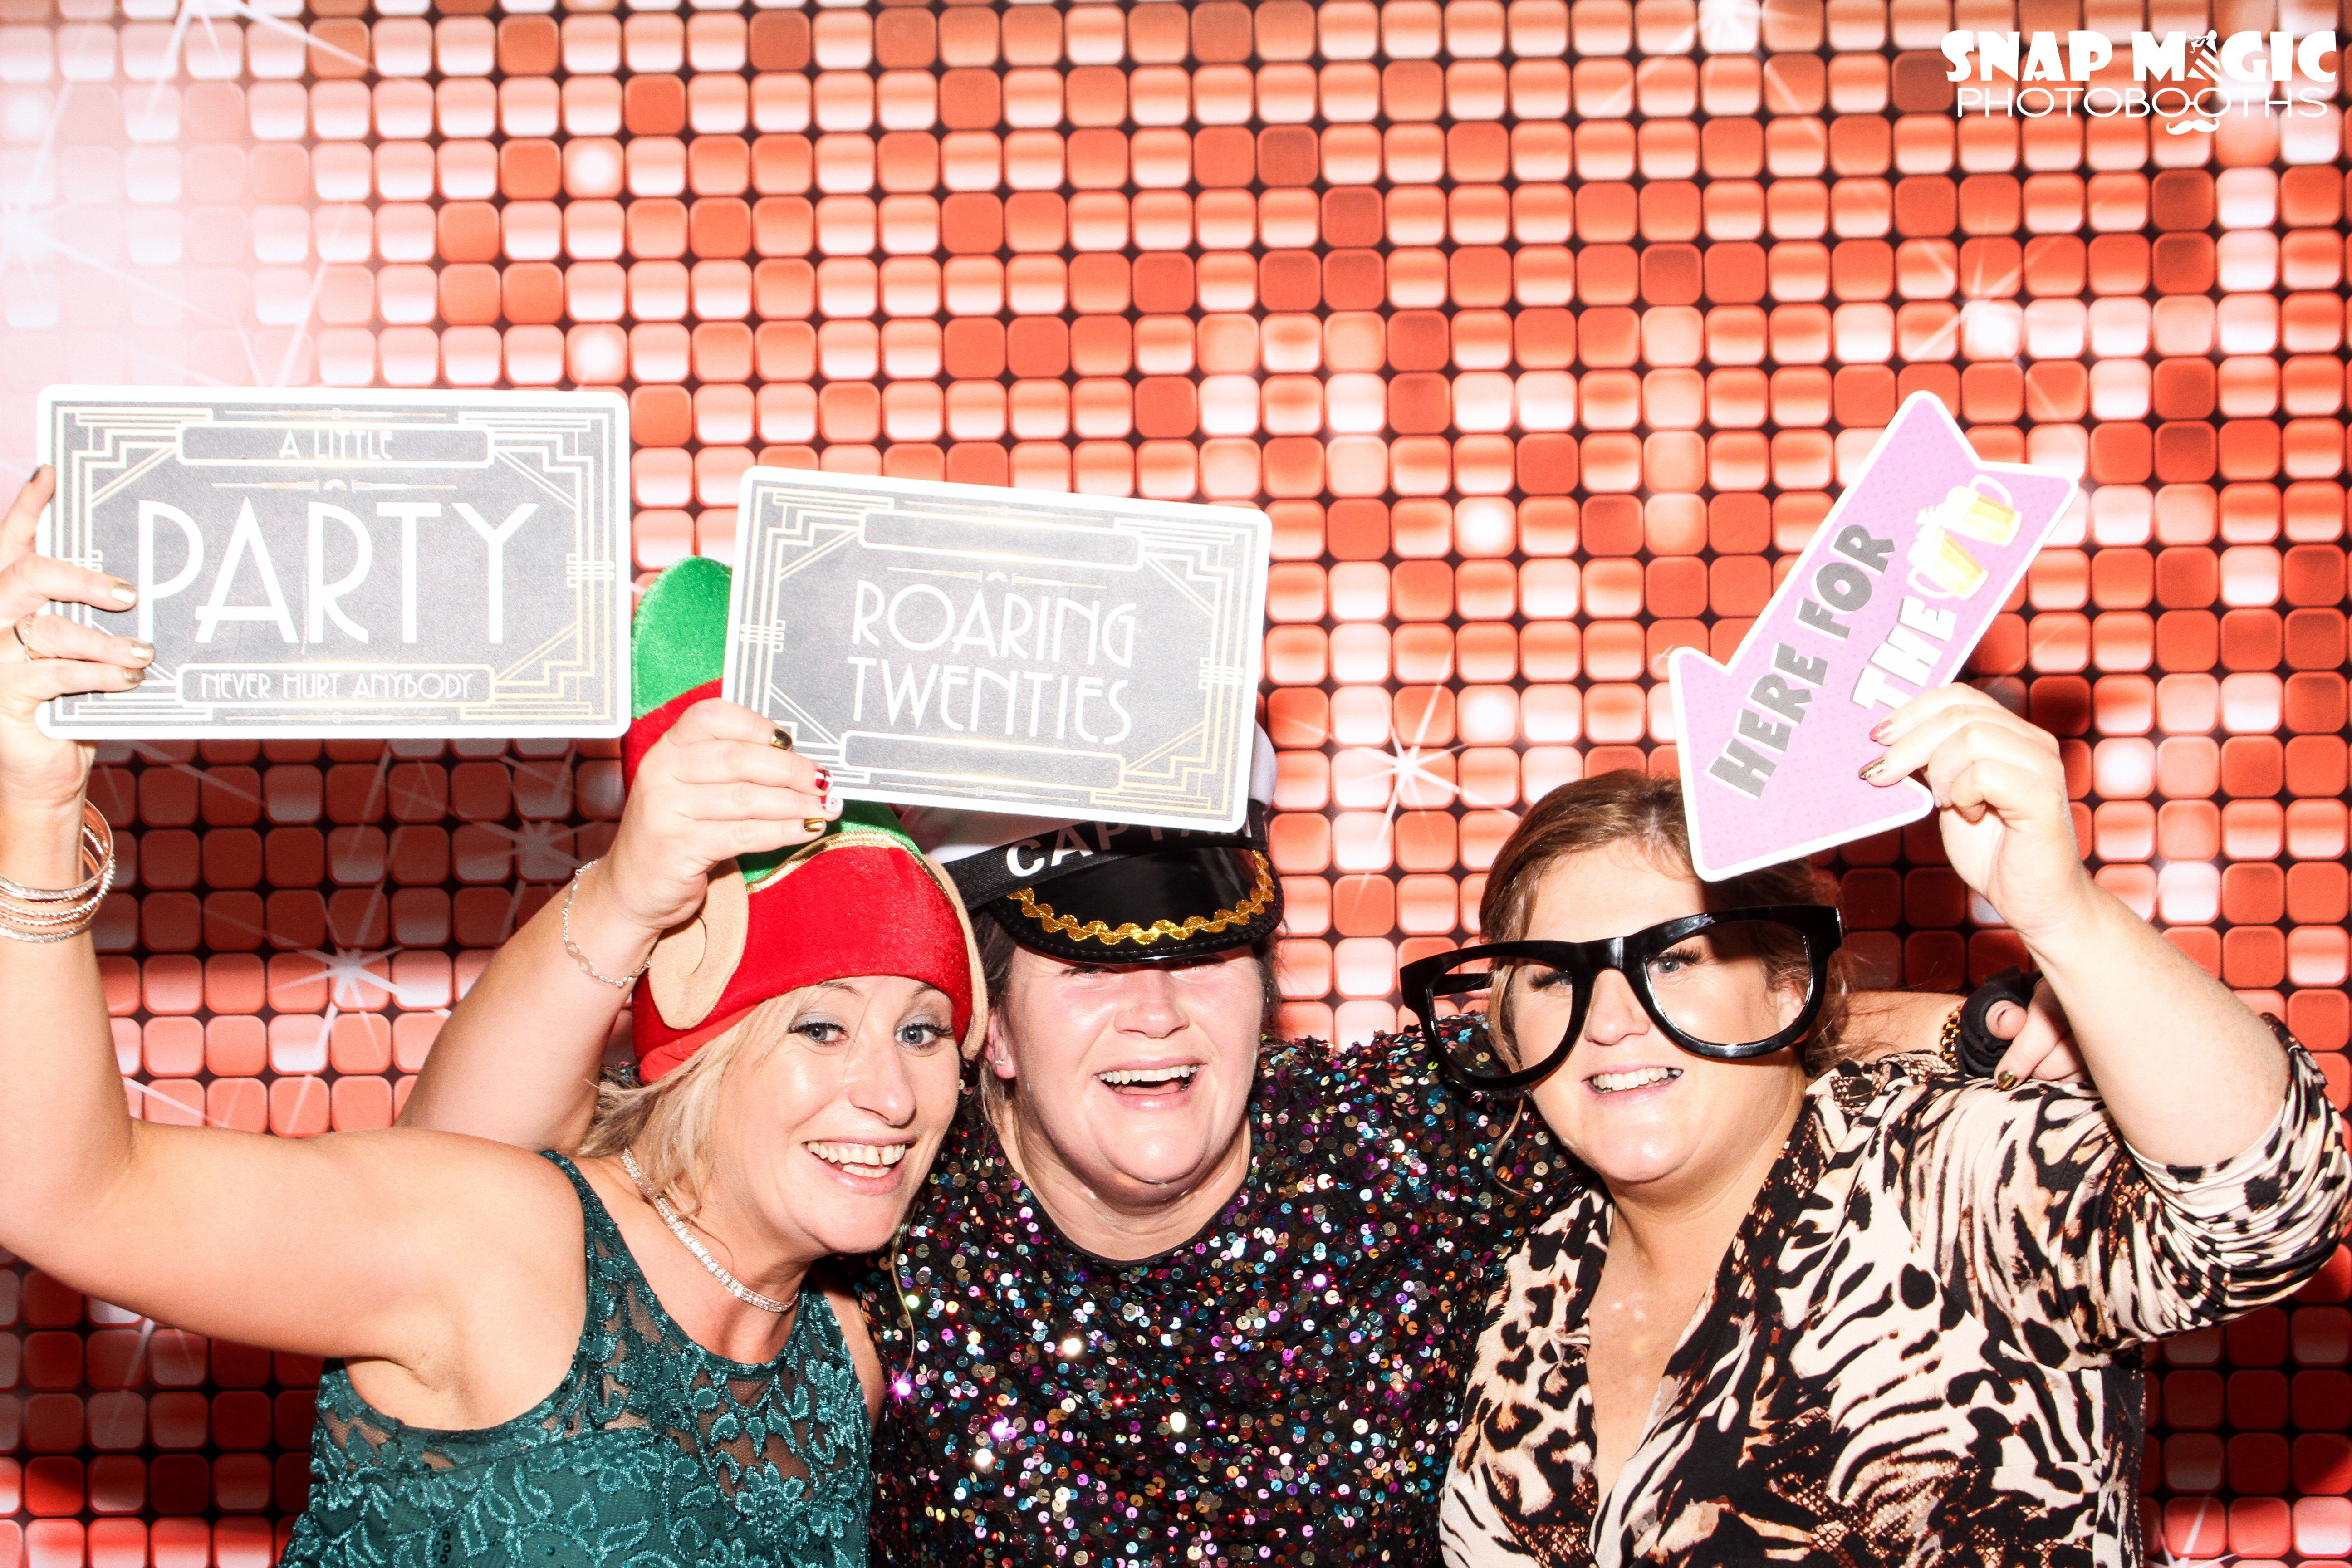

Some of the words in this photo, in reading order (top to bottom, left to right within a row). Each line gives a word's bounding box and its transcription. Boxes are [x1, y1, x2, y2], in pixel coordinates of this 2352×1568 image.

[279, 429, 300, 460] A
[314, 429, 393, 460] LITTLE
[137, 496, 539, 644] PARTY
[851, 579, 1136, 669] ROARING
[1704, 642, 1828, 800] HERE
[1793, 524, 1896, 642] FOR
[1850, 595, 1957, 710] THE
[201, 672, 271, 699] NEVER
[282, 672, 341, 699] HURT
[353, 672, 473, 700] ANYBODY
[847, 656, 1132, 745] TWENTIES
